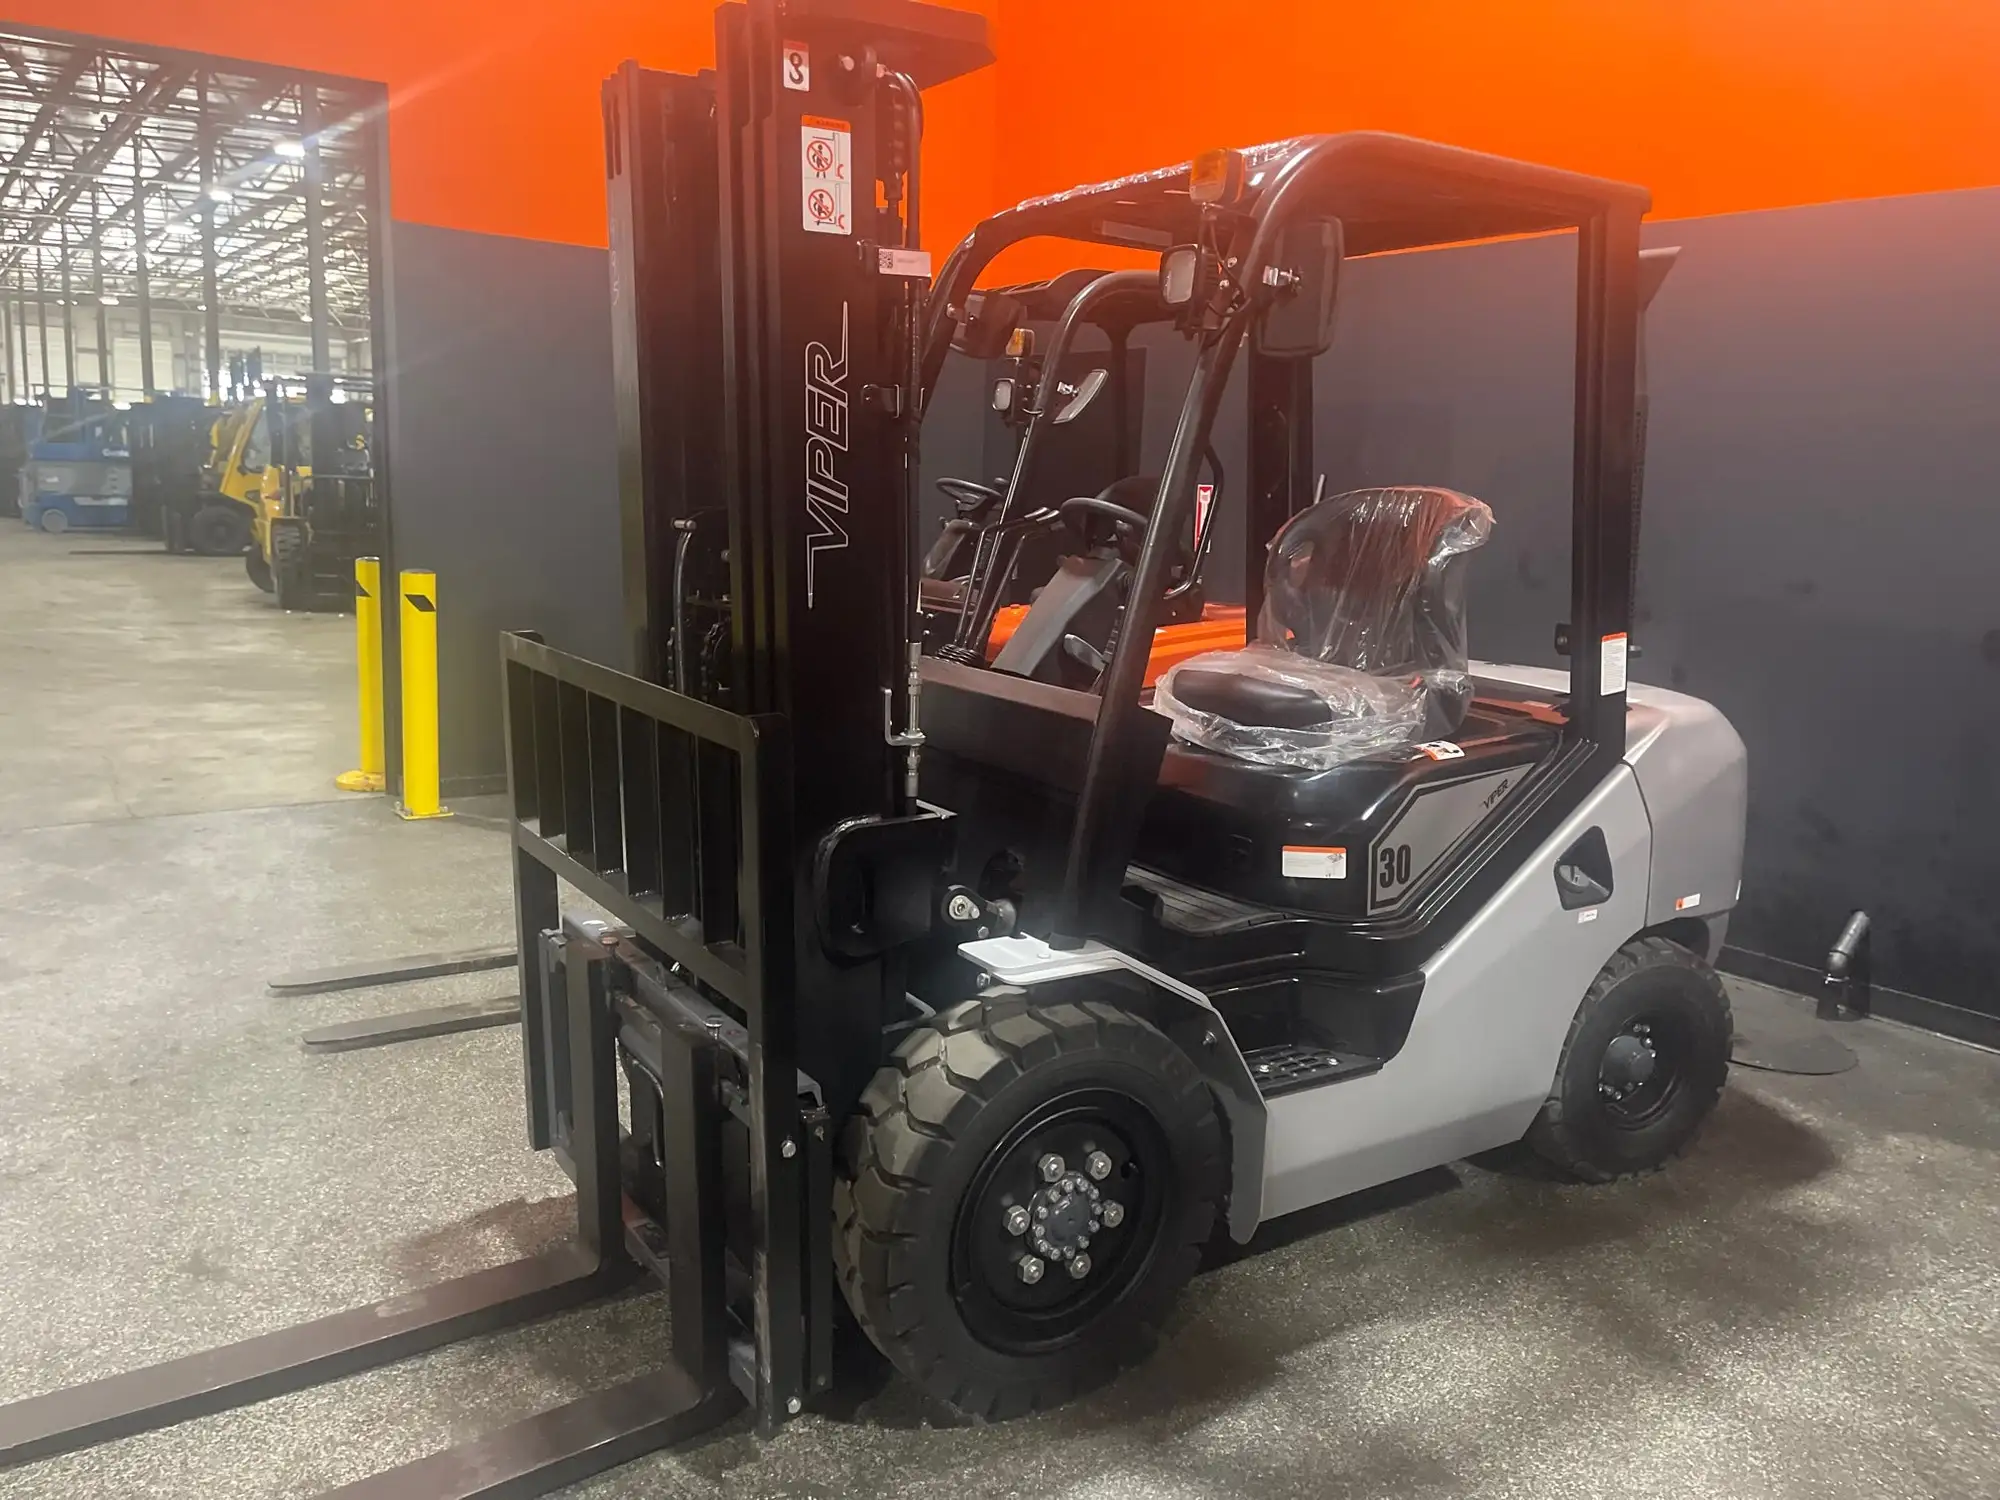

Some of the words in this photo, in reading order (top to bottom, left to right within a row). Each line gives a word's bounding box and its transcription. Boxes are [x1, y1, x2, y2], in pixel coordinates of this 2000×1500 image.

[805, 301, 849, 610] VIPER
[1481, 778, 1510, 810] VIPER
[1379, 844, 1412, 889] 30
